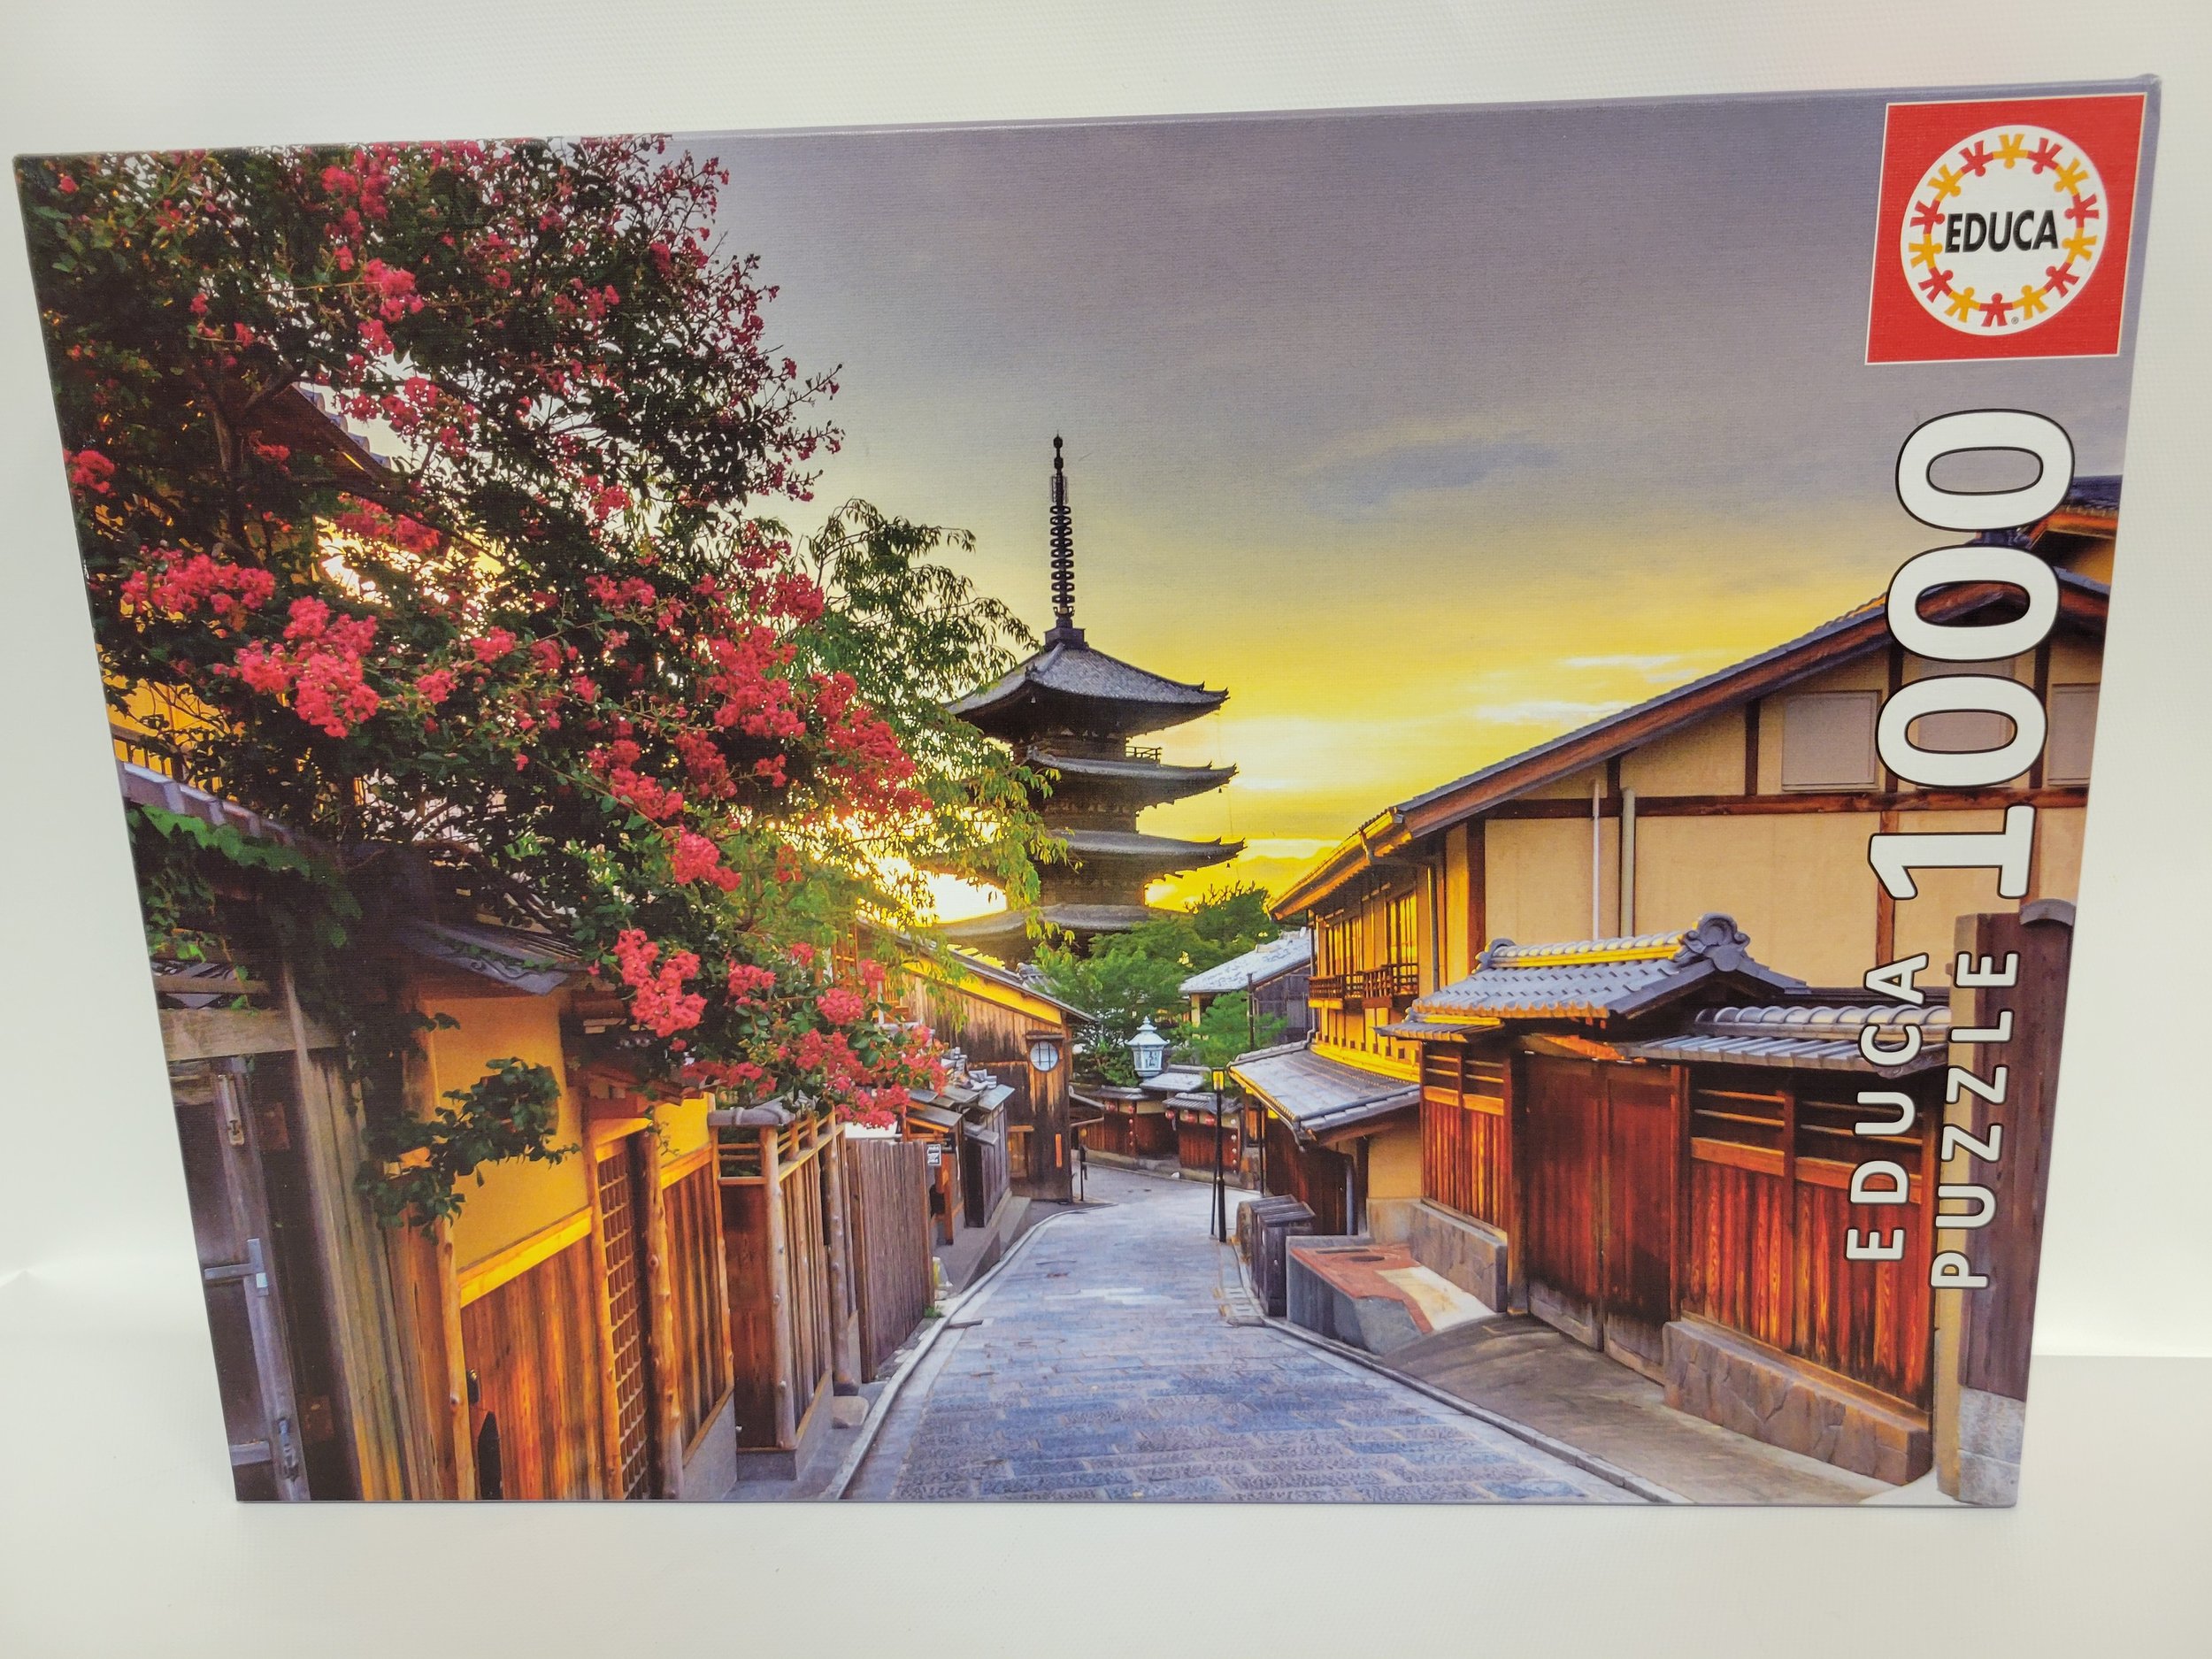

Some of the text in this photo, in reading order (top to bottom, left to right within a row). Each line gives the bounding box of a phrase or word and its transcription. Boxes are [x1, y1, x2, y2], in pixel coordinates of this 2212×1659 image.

[1945, 210, 2059, 253] EDUCA
[1868, 408, 2075, 900] 1000
[1846, 952, 1929, 1261] EDUCA
[1930, 950, 2020, 1289] PUZZLE
